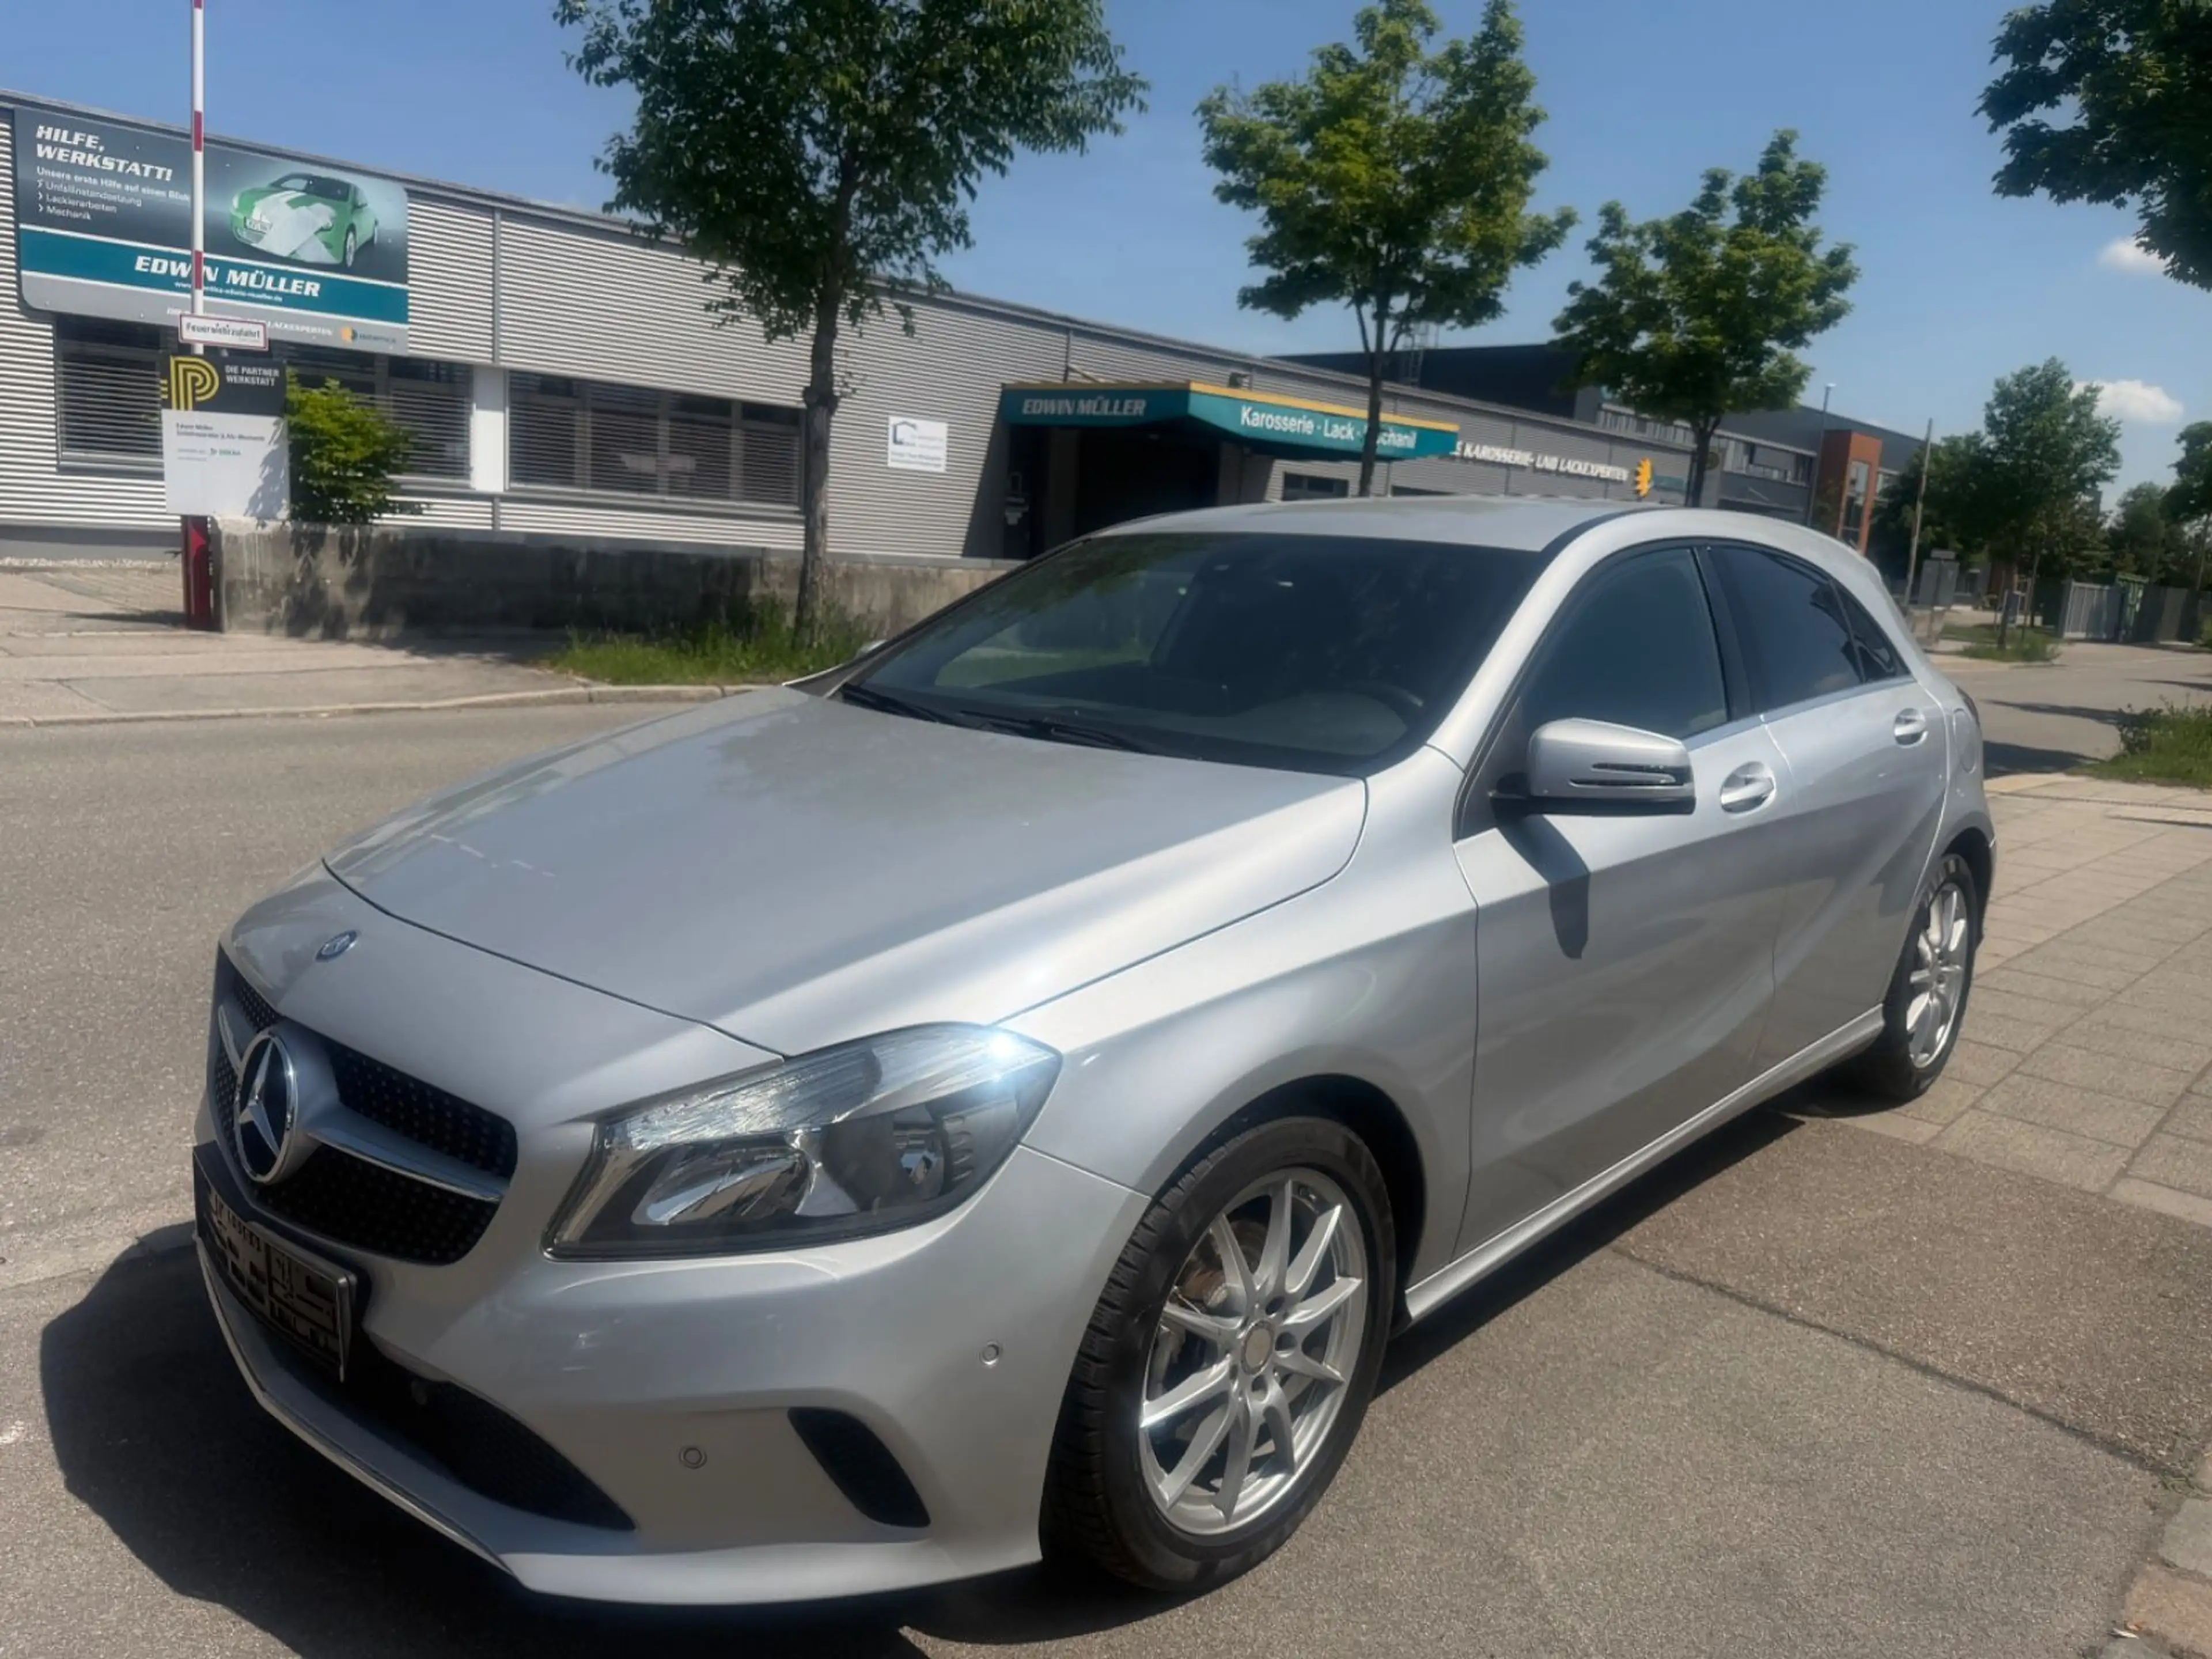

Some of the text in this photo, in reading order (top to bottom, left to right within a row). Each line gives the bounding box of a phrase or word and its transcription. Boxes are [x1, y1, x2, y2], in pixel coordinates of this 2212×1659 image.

[36, 124, 105, 152] HILFE,
[36, 143, 173, 181] WERKSTATT!
[134, 255, 219, 282] EDWN
[226, 270, 321, 297] MÜLLER
[225, 365, 280, 377] DIE PARTNER
[226, 375, 275, 387] WERKSTATT
[1021, 395, 1147, 417] EDWIN MÜLLER
[1240, 404, 1315, 435] Karosserie
[1323, 419, 1355, 441] Lack
